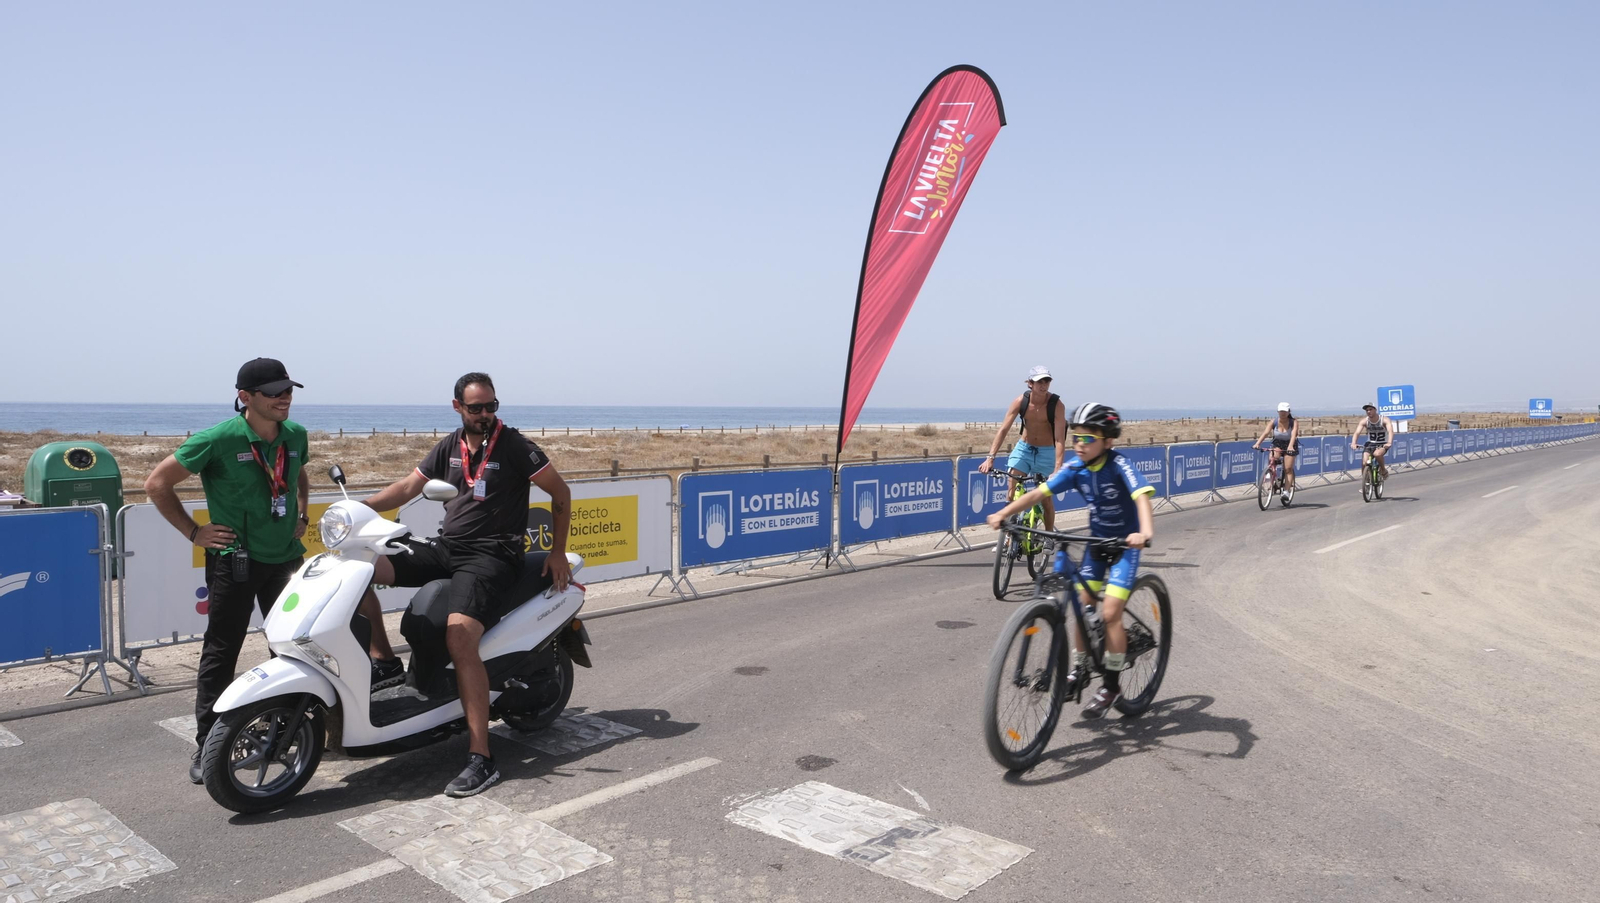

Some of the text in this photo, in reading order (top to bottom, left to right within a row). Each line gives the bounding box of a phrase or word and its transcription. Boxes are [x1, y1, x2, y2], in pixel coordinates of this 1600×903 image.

[903, 119, 960, 221] LA VUELTA
[1379, 403, 1415, 412] LOTERÍAS
[1186, 454, 1211, 468] LOTERÍAS
[1231, 451, 1254, 463] LOTERÍAS
[884, 477, 944, 499] LOTERÍAS
[741, 488, 820, 513] LOTERÍAS
[889, 501, 939, 514] CON EL DEPORTE
[570, 507, 609, 521] efecto
[570, 521, 622, 536] bicicleta
[747, 515, 814, 530] CON EL DEPORTE
[570, 542, 596, 551] Cuando
[606, 539, 628, 547] sumas,
[587, 550, 609, 558] rueda.
